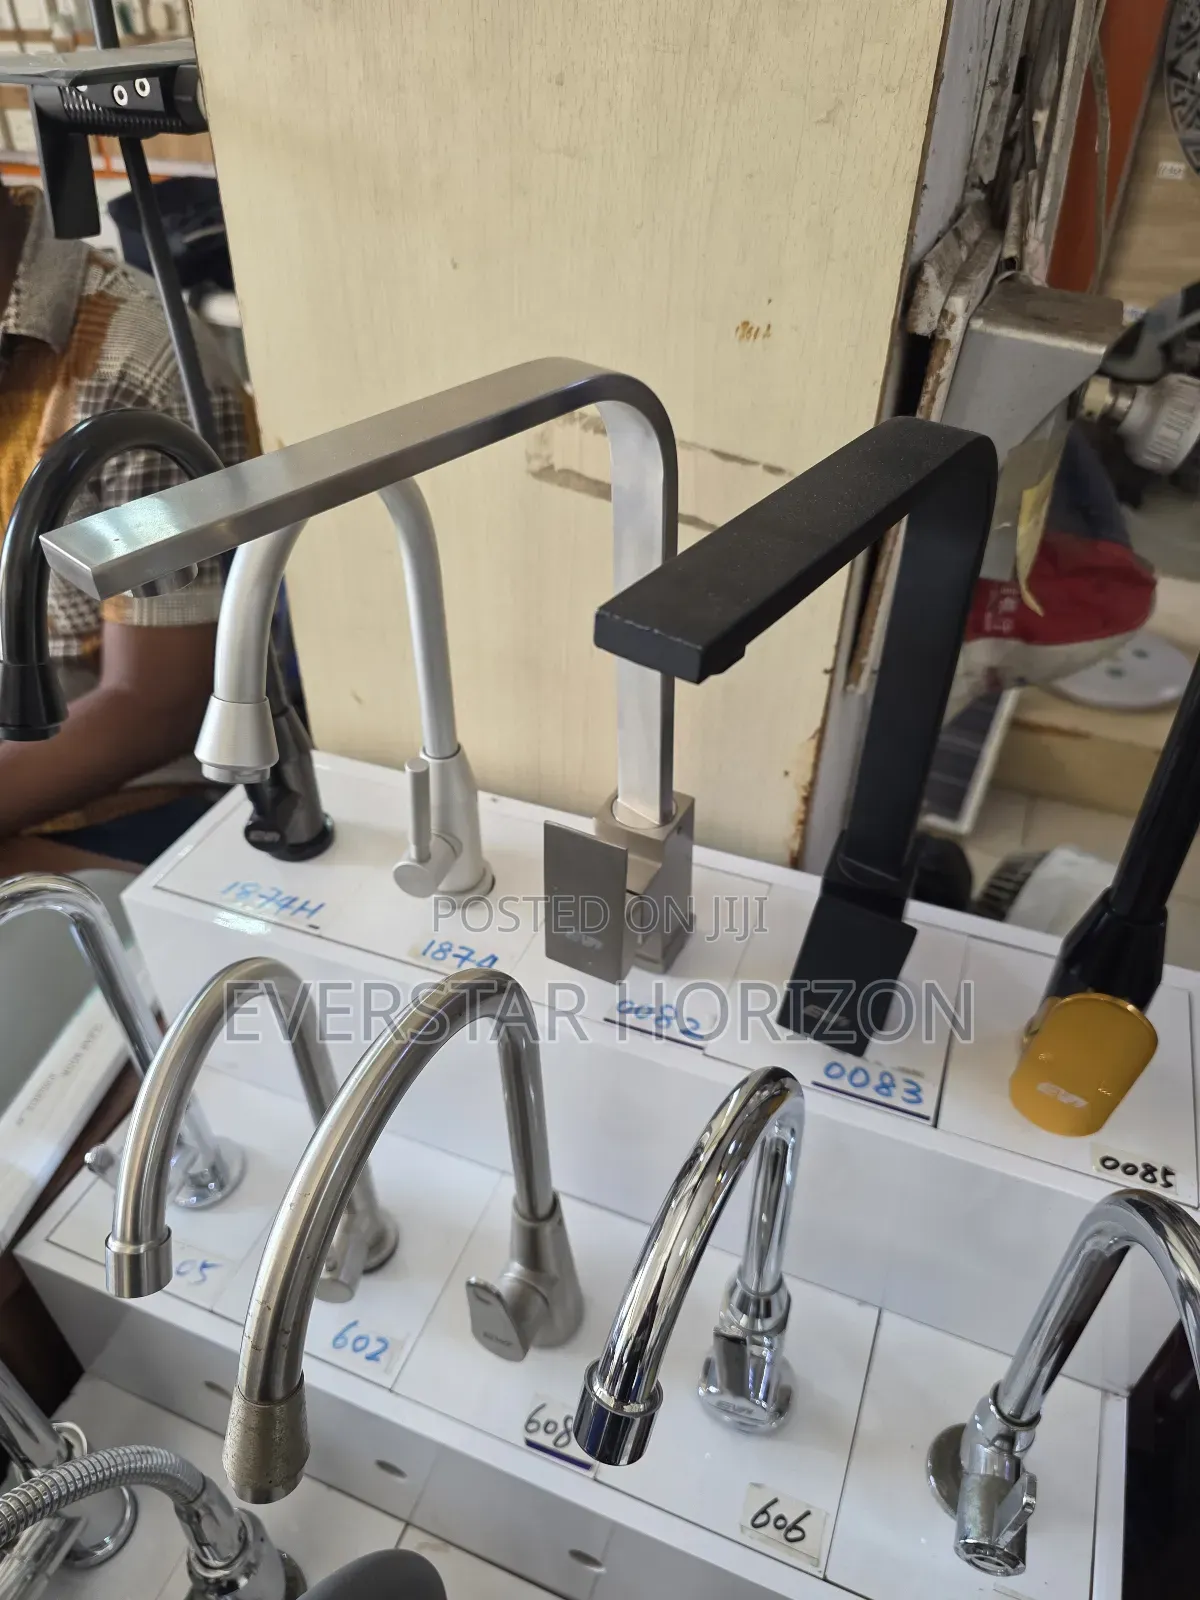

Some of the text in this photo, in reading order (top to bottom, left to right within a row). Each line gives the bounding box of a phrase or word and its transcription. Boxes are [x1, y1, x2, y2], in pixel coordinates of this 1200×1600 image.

[617, 1000, 704, 1038] 0082
[823, 1061, 924, 1104] 0083
[1100, 1155, 1176, 1189] 0085
[174, 1258, 224, 1286] 05
[332, 1319, 389, 1362] 602
[524, 1402, 574, 1448] 608
[751, 1497, 811, 1542] 606
